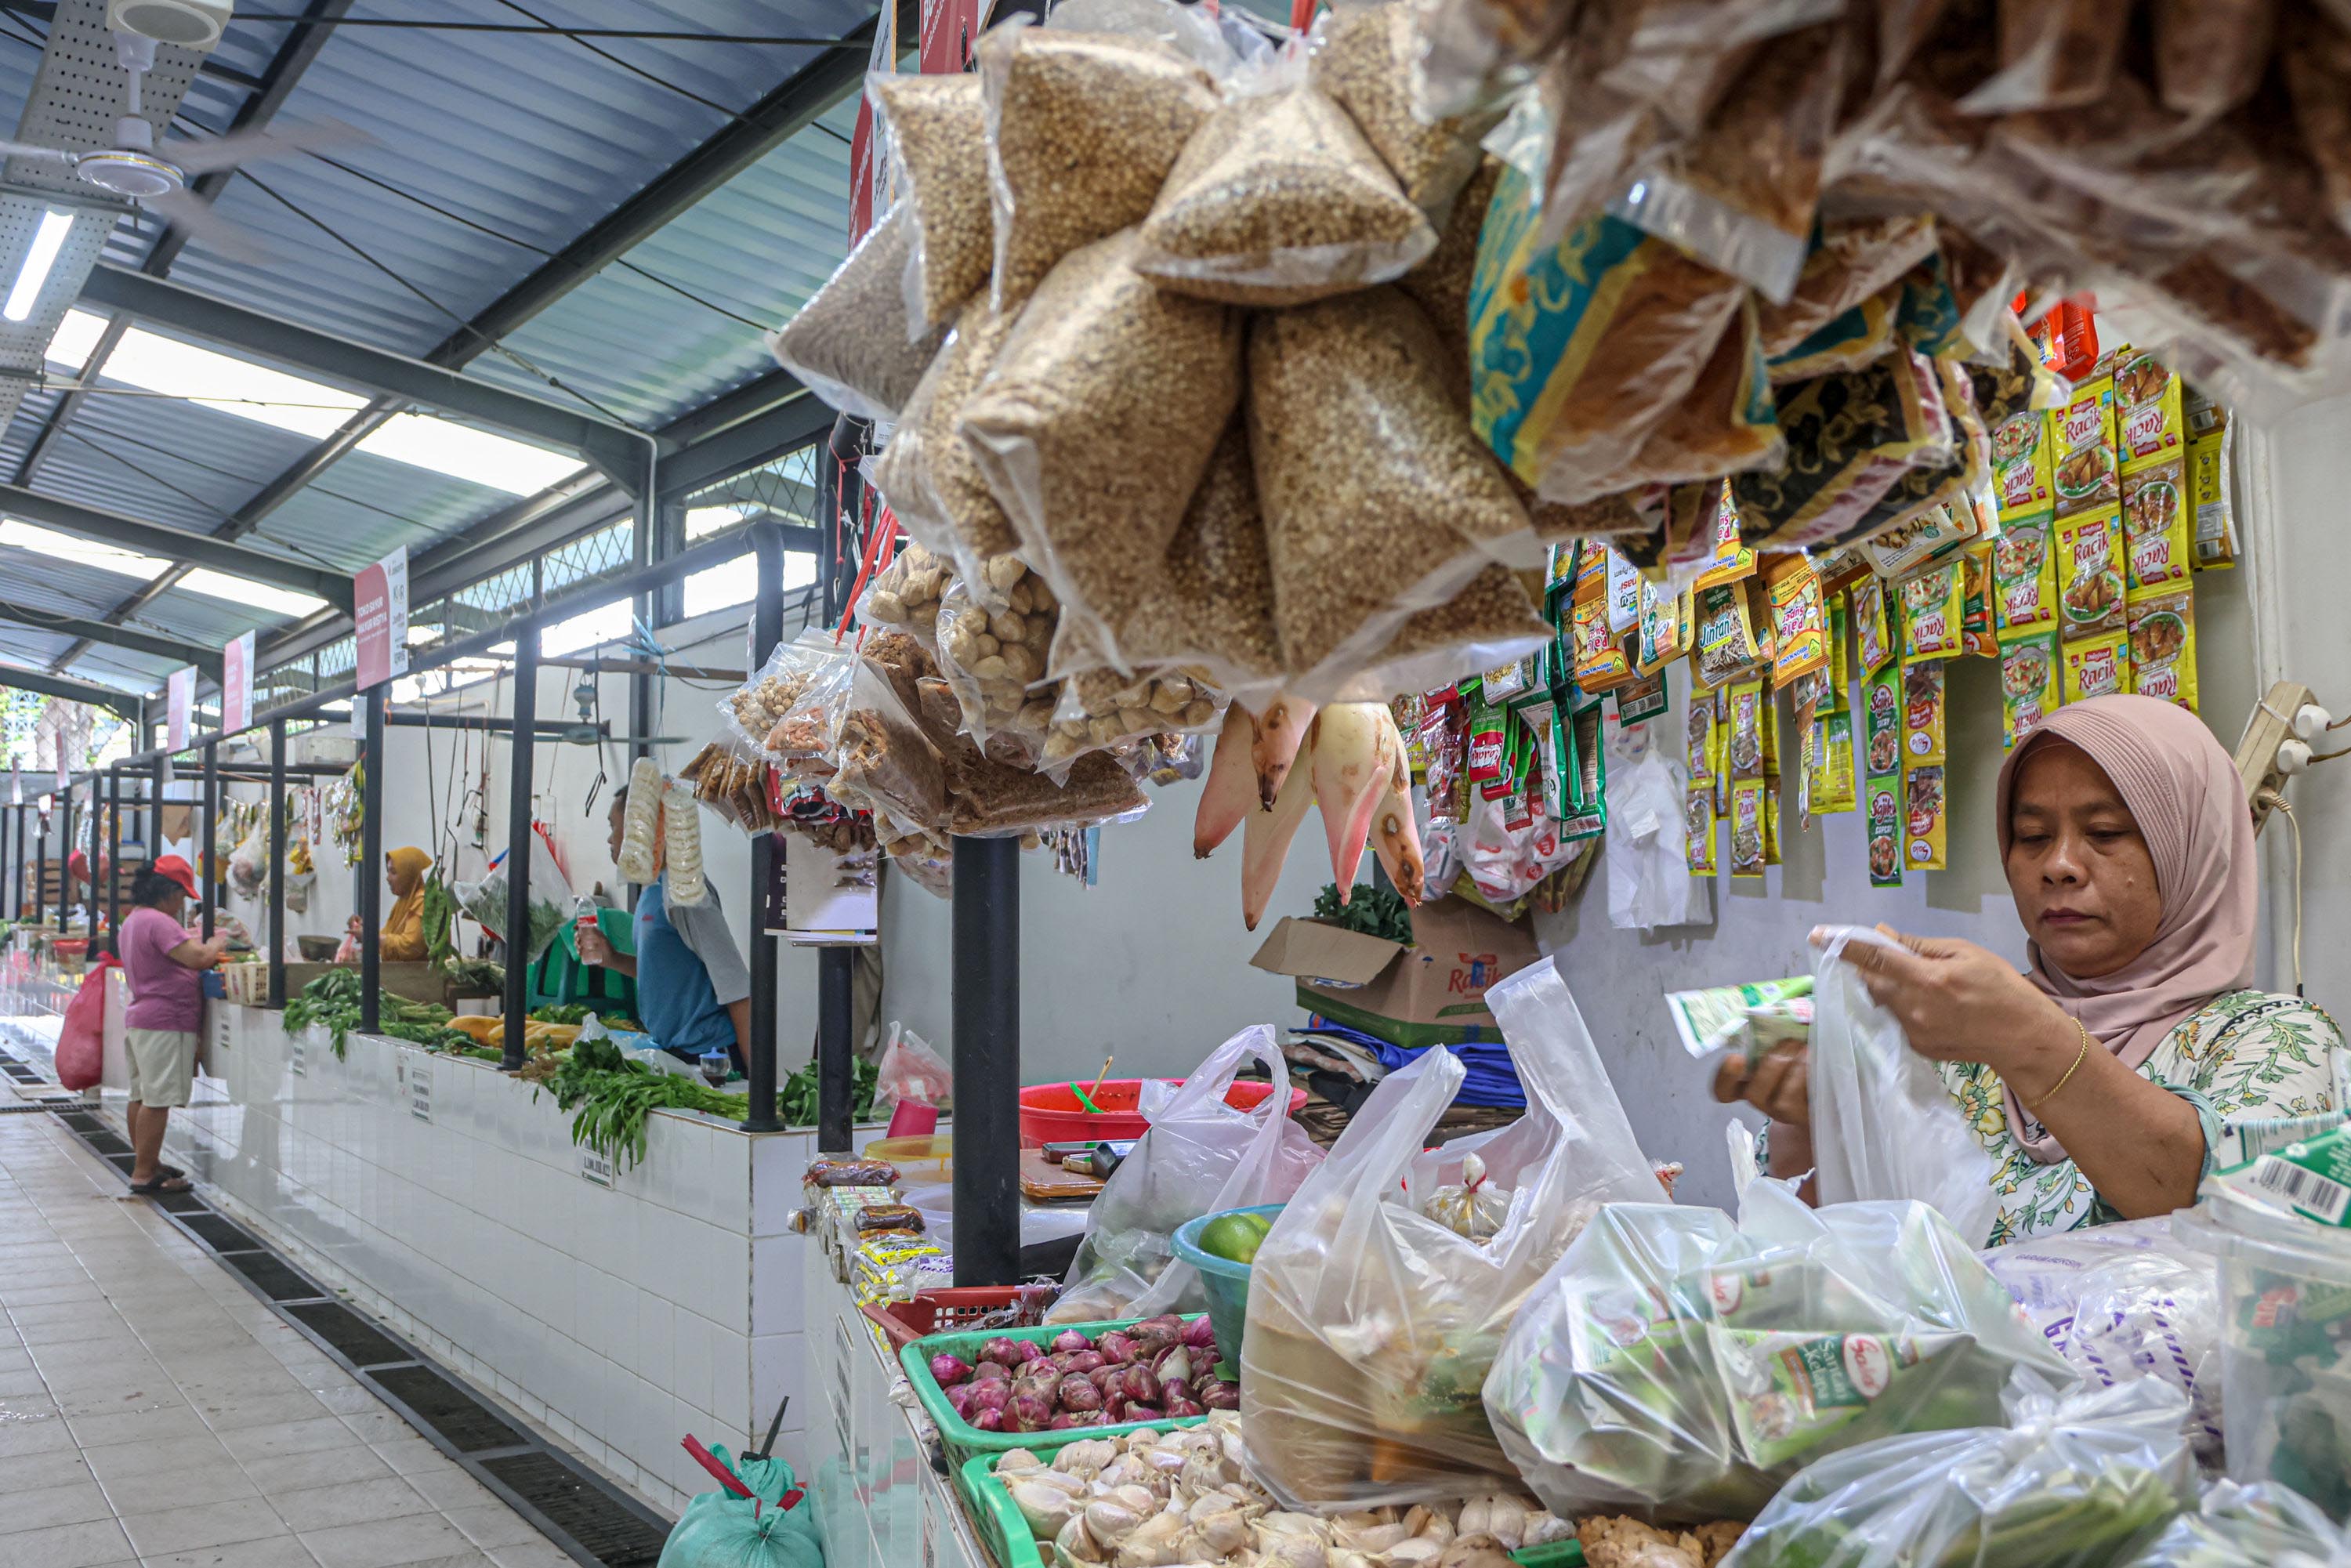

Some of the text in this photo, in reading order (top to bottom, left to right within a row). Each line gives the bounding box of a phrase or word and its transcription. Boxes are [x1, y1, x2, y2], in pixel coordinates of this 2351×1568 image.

[2066, 407, 2103, 443] Racik
[2125, 411, 2163, 446] Racik
[2004, 465, 2034, 497] Racik
[2074, 532, 2110, 565] Racik
[2132, 542, 2169, 574] Racik
[1782, 617, 1804, 638] Pala
[1783, 605, 1804, 624] Super
[1700, 620, 1731, 648] Jintan
[1914, 617, 1946, 644] Racik
[2079, 660, 2117, 690] Racik
